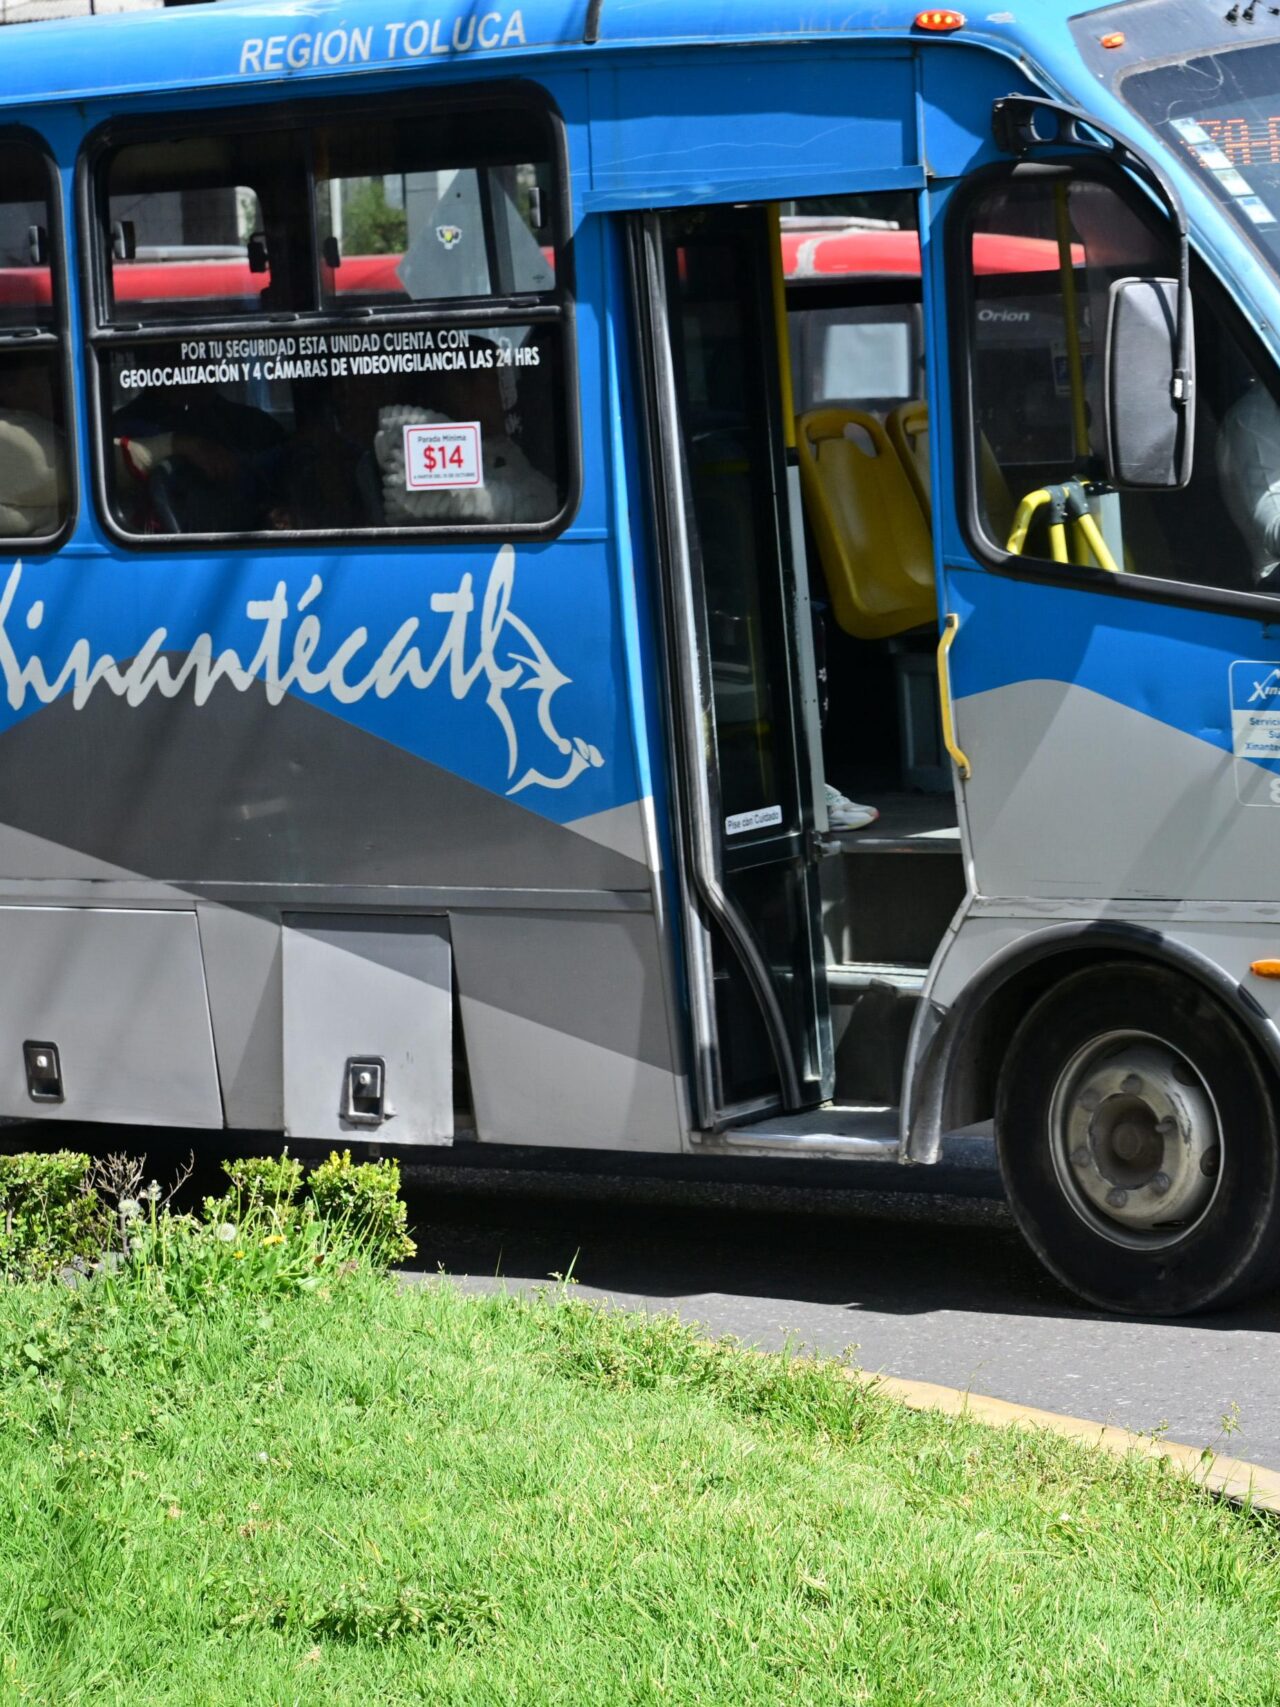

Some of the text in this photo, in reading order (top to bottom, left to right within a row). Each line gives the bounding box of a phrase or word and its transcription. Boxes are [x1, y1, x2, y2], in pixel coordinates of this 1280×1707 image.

[239, 9, 527, 74] REGIÓN TOLUCA
[977, 308, 1031, 322] Orion
[181, 330, 470, 360] POR TU SEGURIDAD ESTA UNIDAD CUENTA CON
[119, 346, 540, 388] GEOLOCALIZACIÓN Y 4 CÁMARAS DE VIDEOVIGILANCIA LAS 24 HRS
[423, 444, 464, 472] $14
